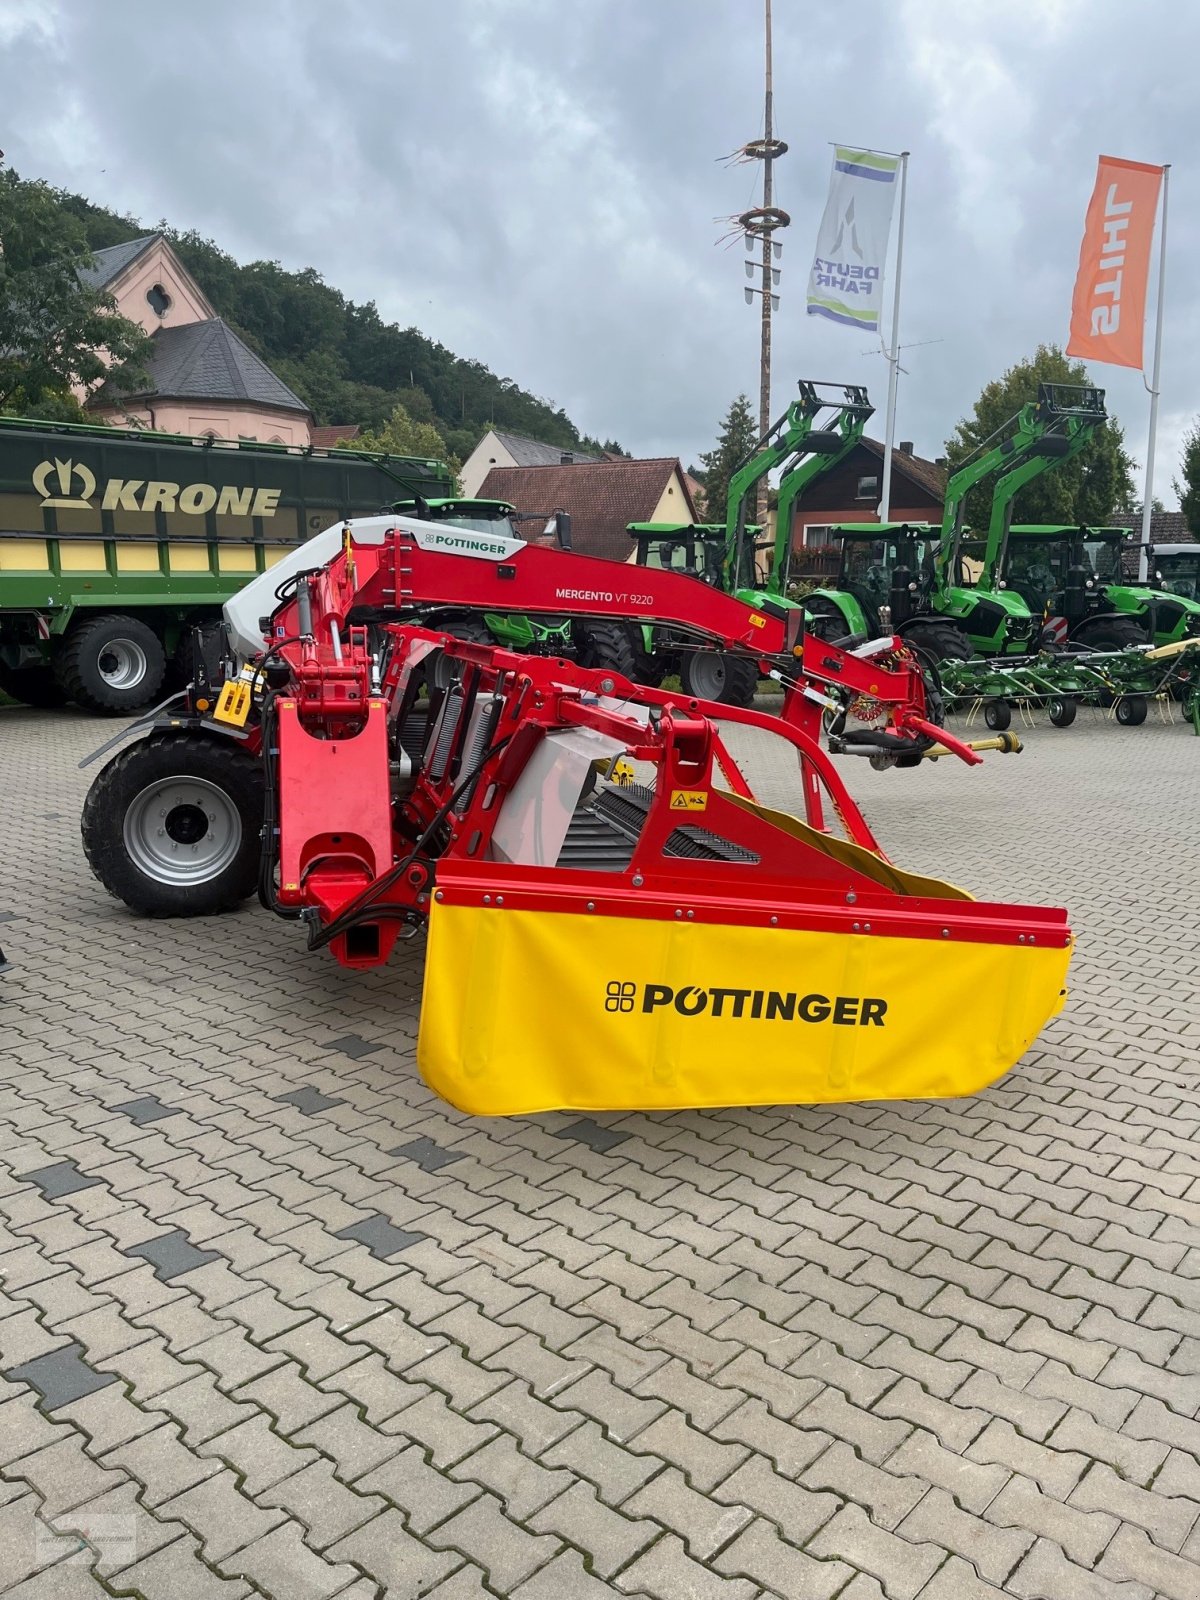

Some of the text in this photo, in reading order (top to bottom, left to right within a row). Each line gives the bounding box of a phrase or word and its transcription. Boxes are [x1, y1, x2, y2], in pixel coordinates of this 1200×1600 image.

[101, 478, 282, 517] KRONE
[435, 535, 506, 555] PÖTTINGER
[555, 588, 654, 605] MERGENTO VT 9220
[642, 983, 888, 1027] PÖTTINGER
